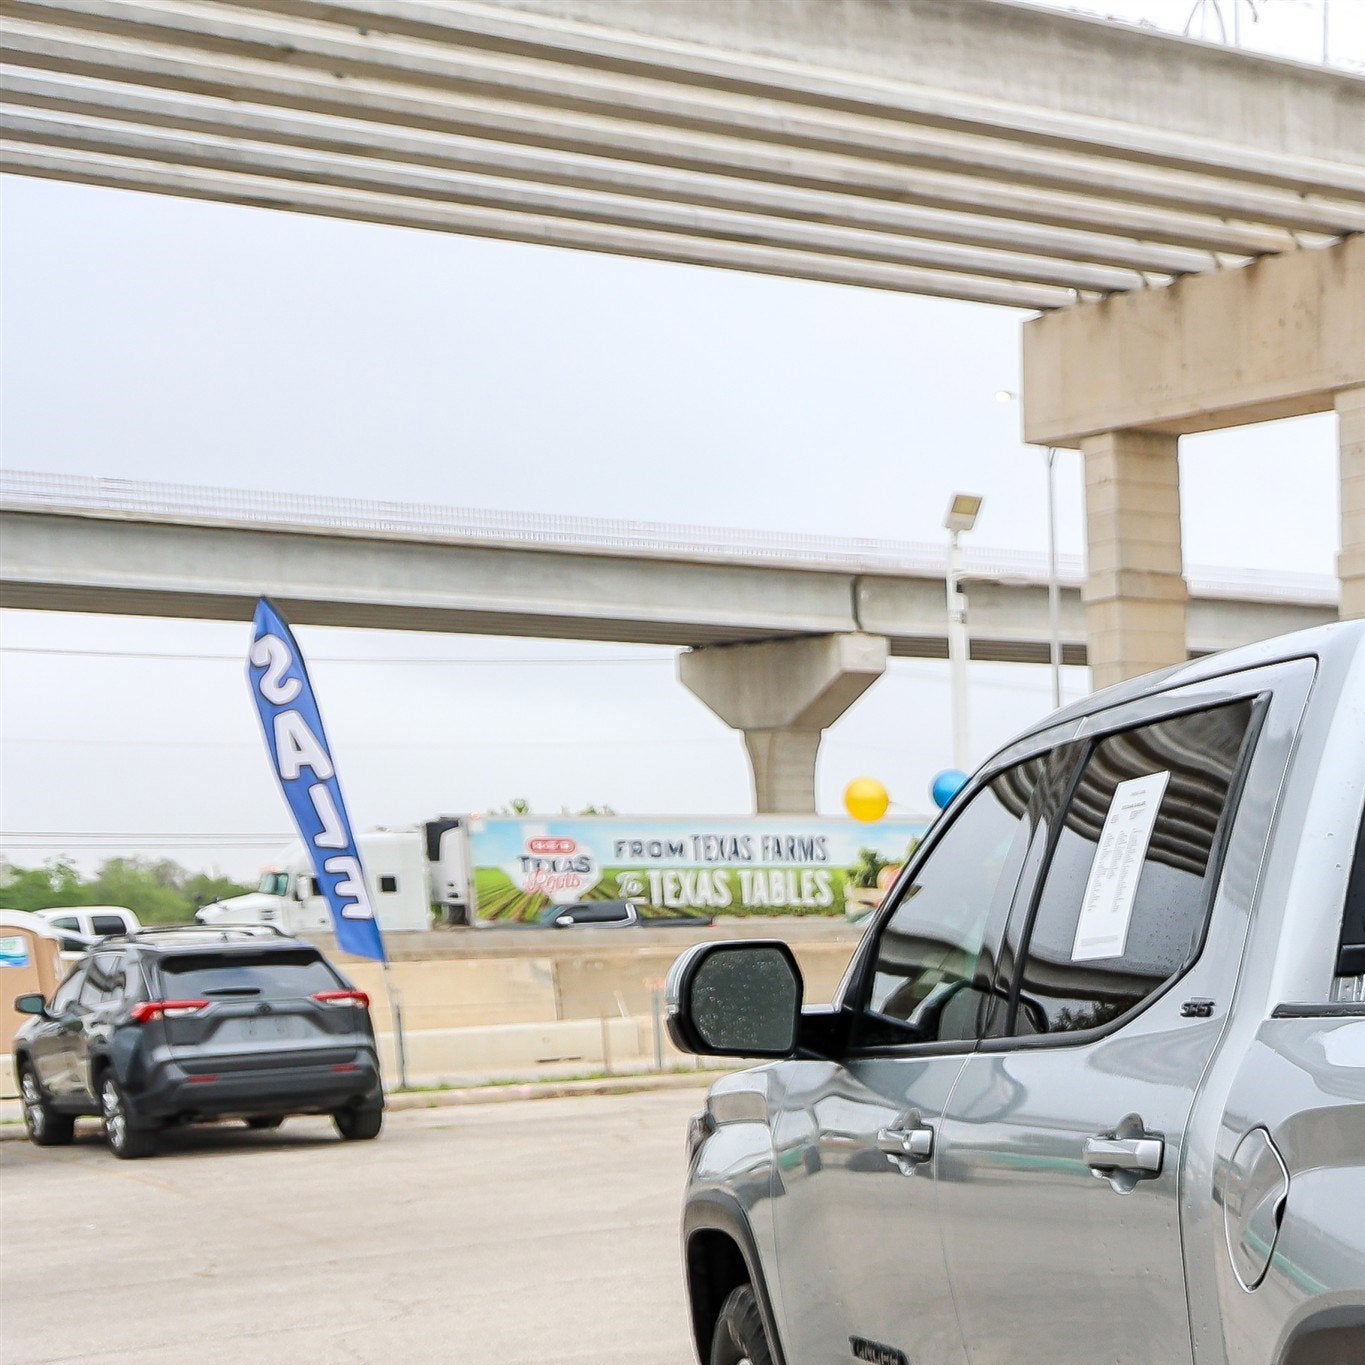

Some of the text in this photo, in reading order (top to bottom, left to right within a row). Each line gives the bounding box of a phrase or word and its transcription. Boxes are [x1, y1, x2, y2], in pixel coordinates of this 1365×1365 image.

[614, 834, 829, 862] FROM TEXAS FARMS
[647, 869, 732, 907] TEXAS
[737, 869, 832, 908] TABLES
